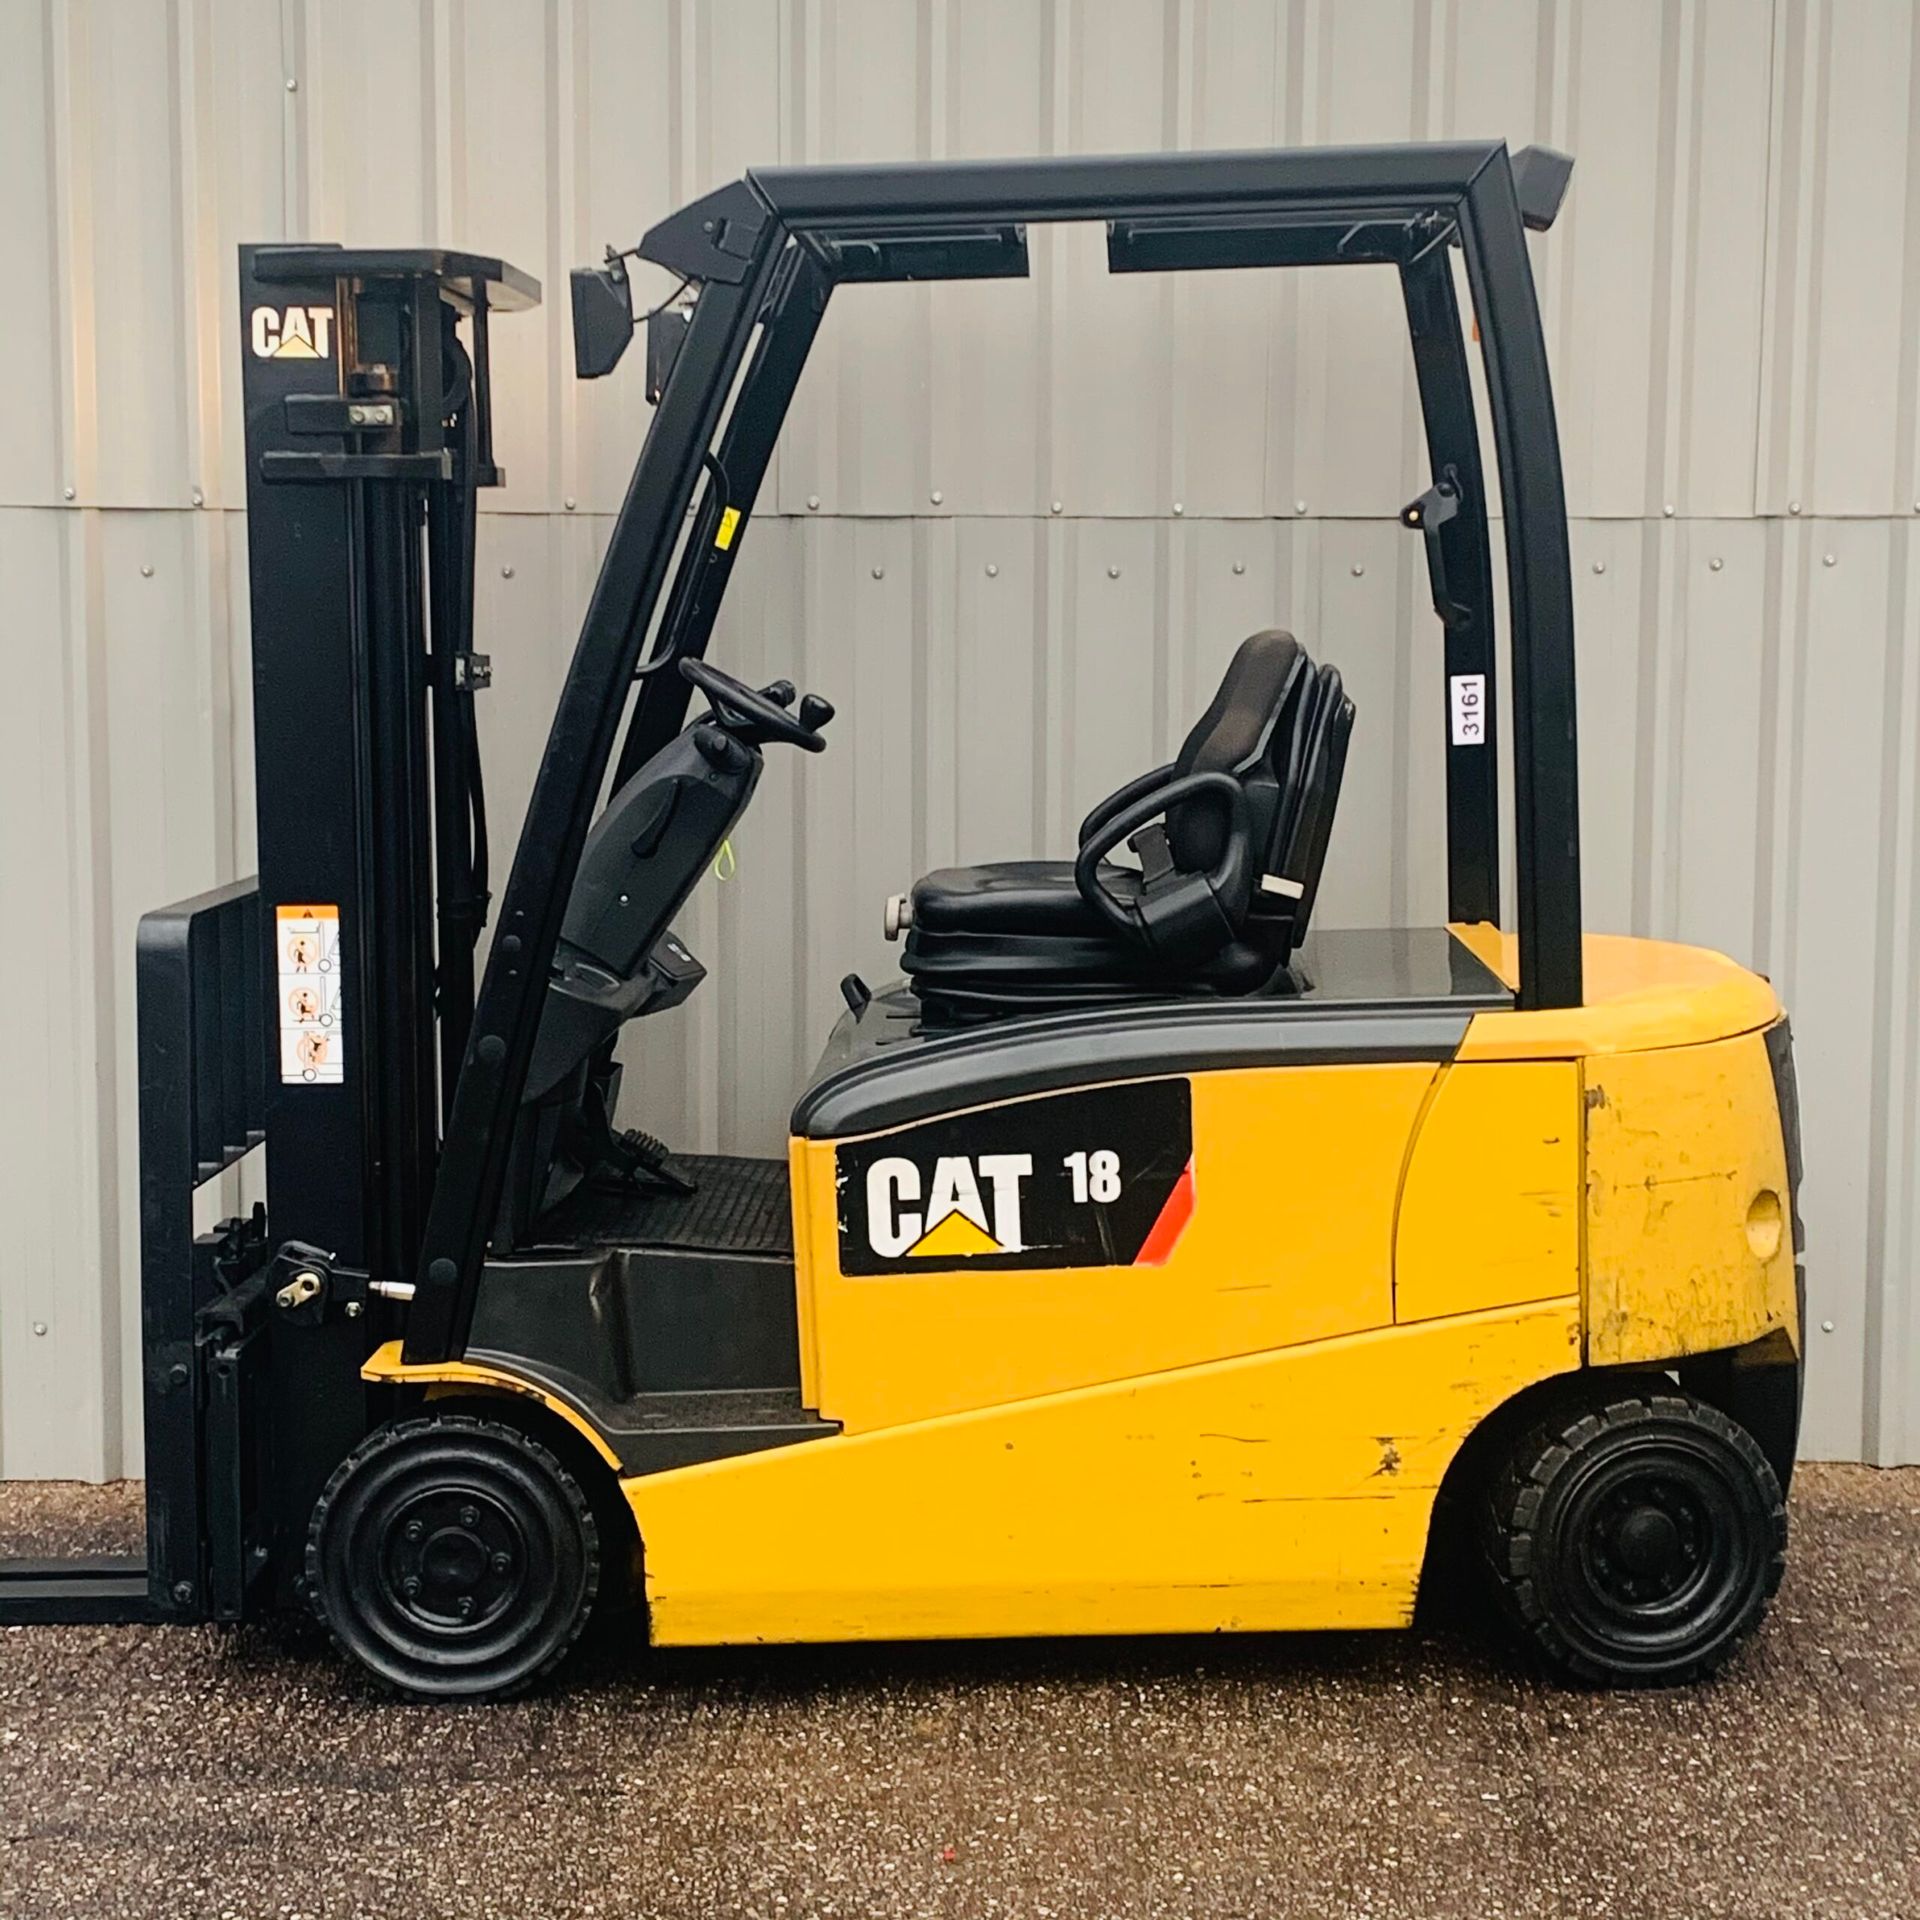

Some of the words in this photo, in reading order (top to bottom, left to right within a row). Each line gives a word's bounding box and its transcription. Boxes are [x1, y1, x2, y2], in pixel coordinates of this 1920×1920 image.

[252, 306, 333, 358] CAT
[1461, 682, 1479, 735] 3161
[866, 1154, 1032, 1258] CAT
[1063, 1150, 1121, 1203] 18
